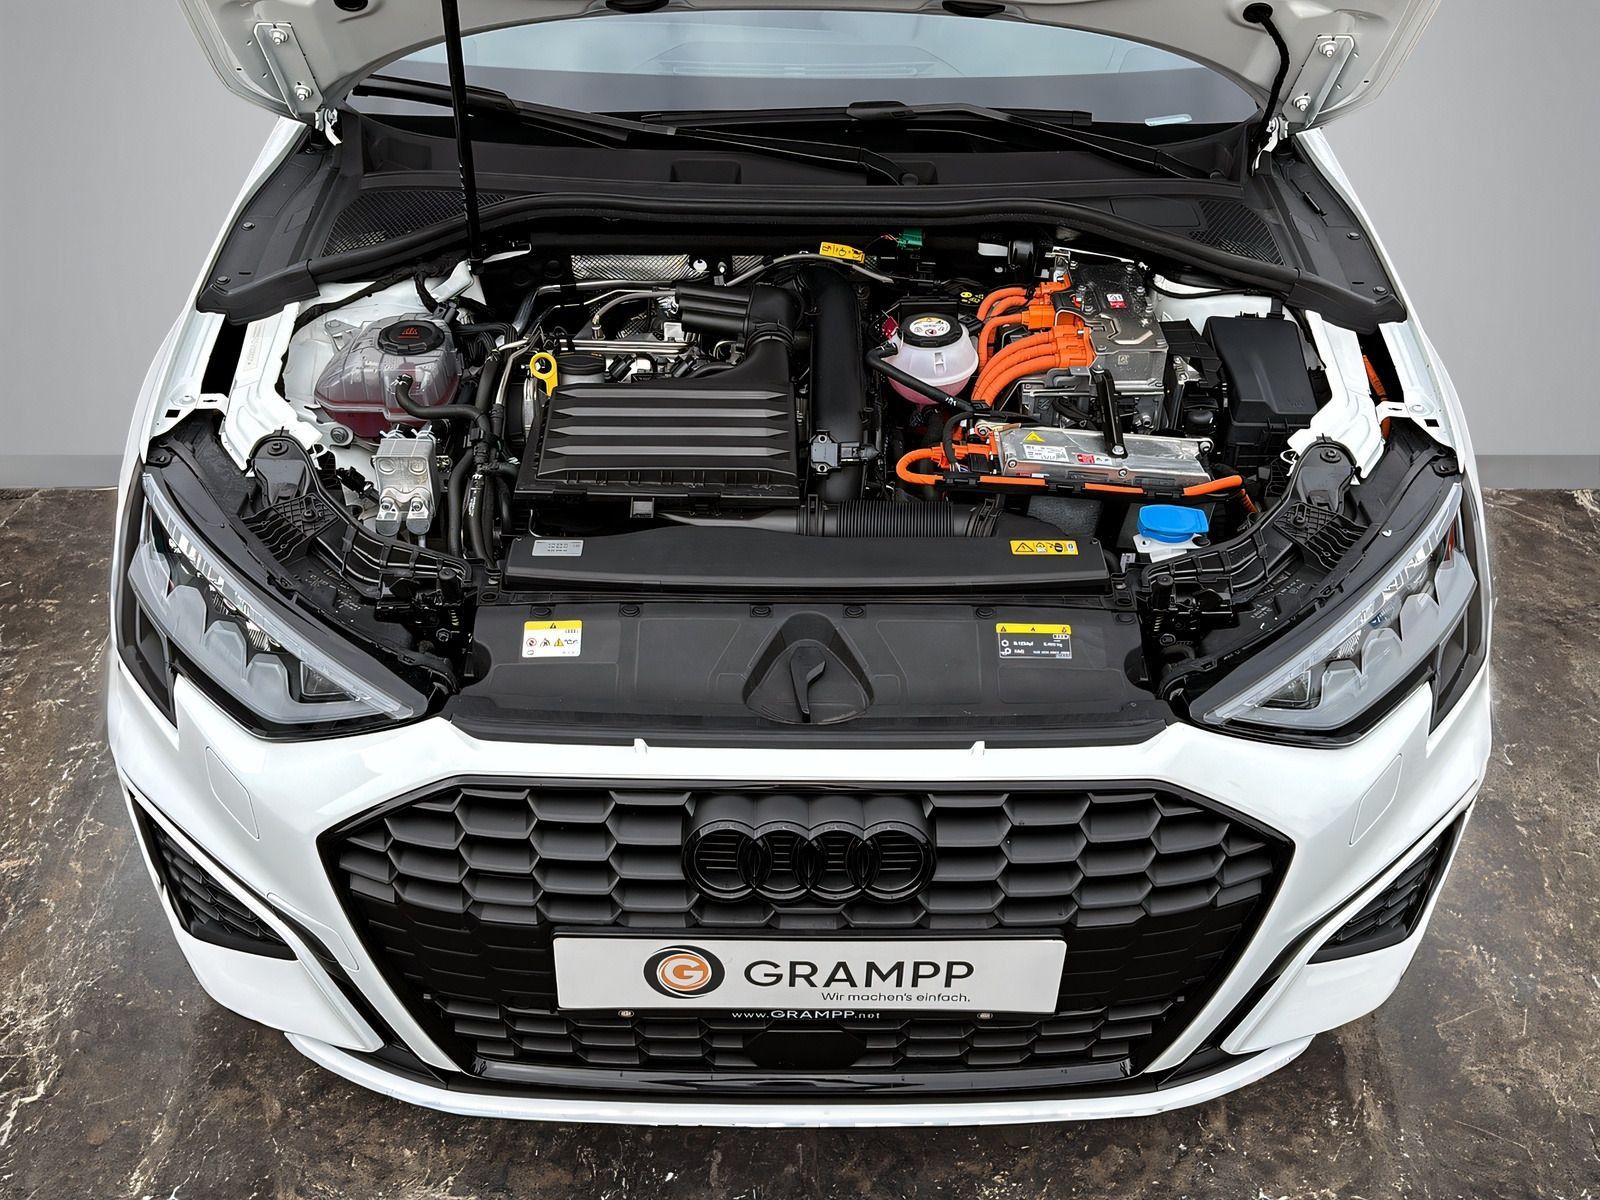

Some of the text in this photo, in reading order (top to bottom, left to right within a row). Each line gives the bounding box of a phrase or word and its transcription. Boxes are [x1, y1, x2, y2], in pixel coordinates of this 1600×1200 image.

[664, 958, 704, 986] G
[743, 959, 975, 989] GRAMPP
[821, 992, 971, 1003] Wir machen's einfach.
[731, 1009, 881, 1020] www.GRAMPP.net
